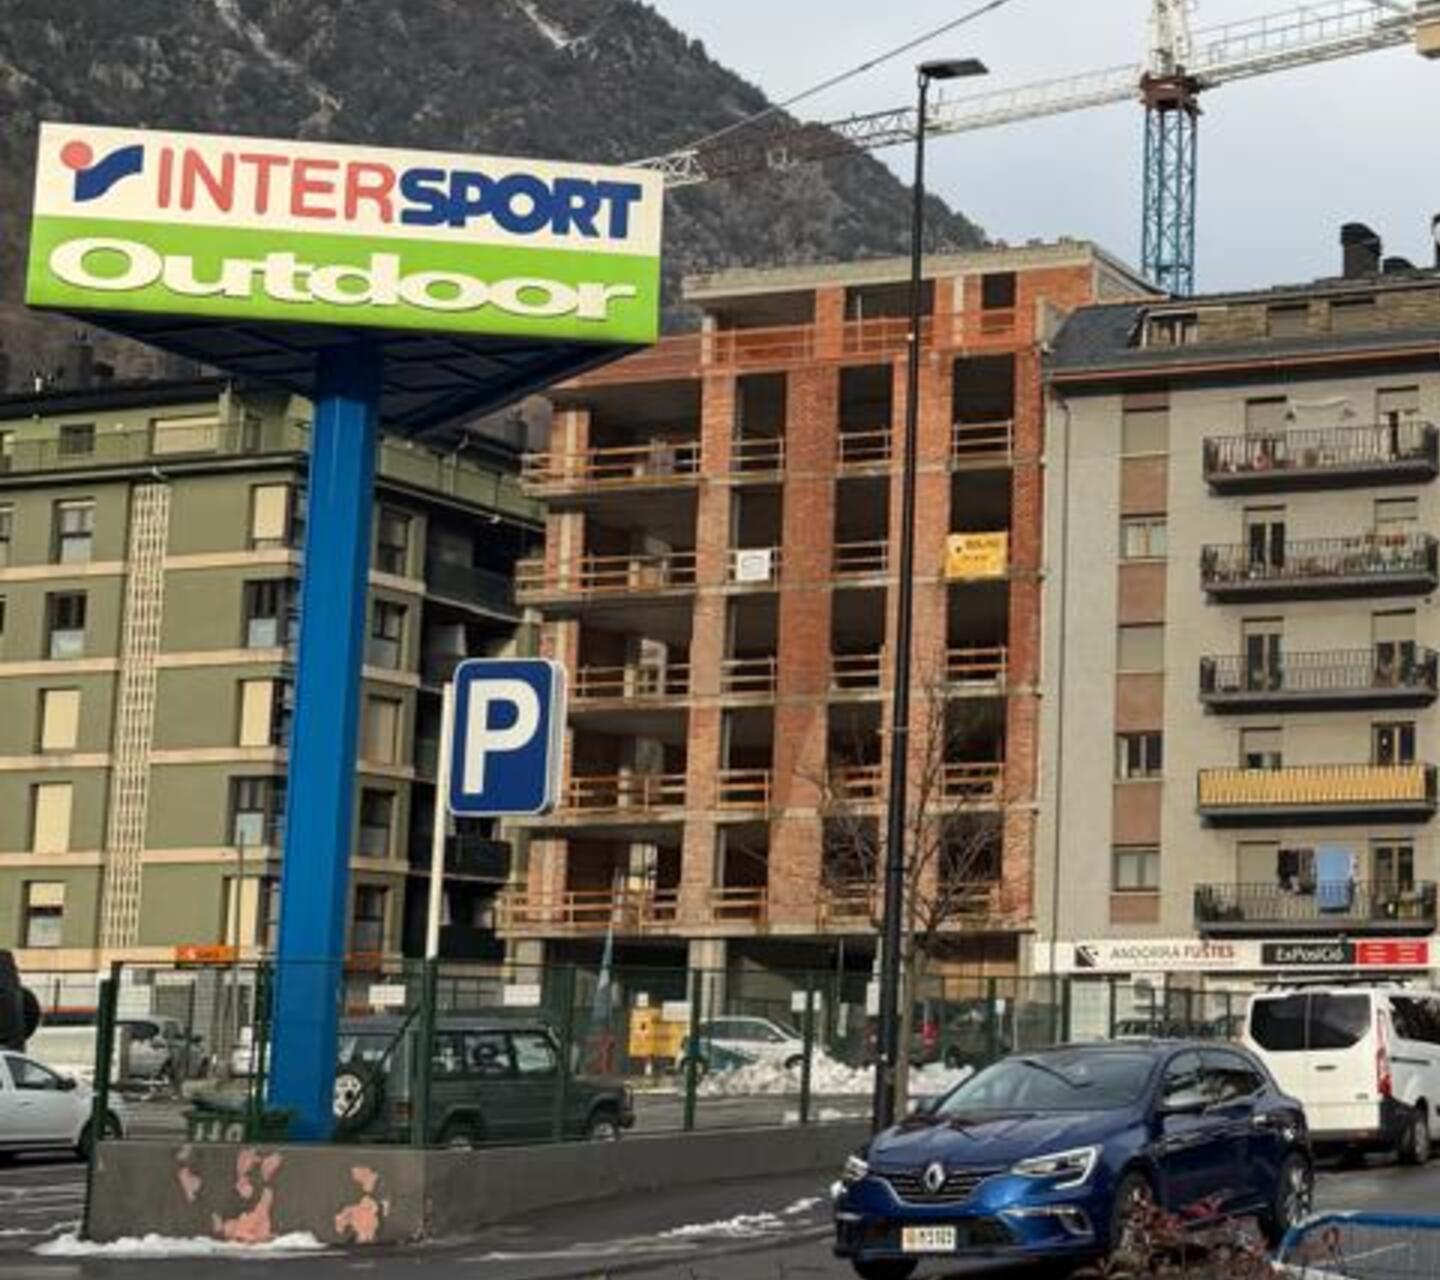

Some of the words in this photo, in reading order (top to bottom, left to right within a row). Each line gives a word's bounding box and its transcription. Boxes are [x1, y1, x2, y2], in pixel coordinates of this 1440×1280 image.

[157, 146, 643, 238] INTERSPORT
[48, 236, 637, 320] Outdoor
[463, 679, 540, 794] P
